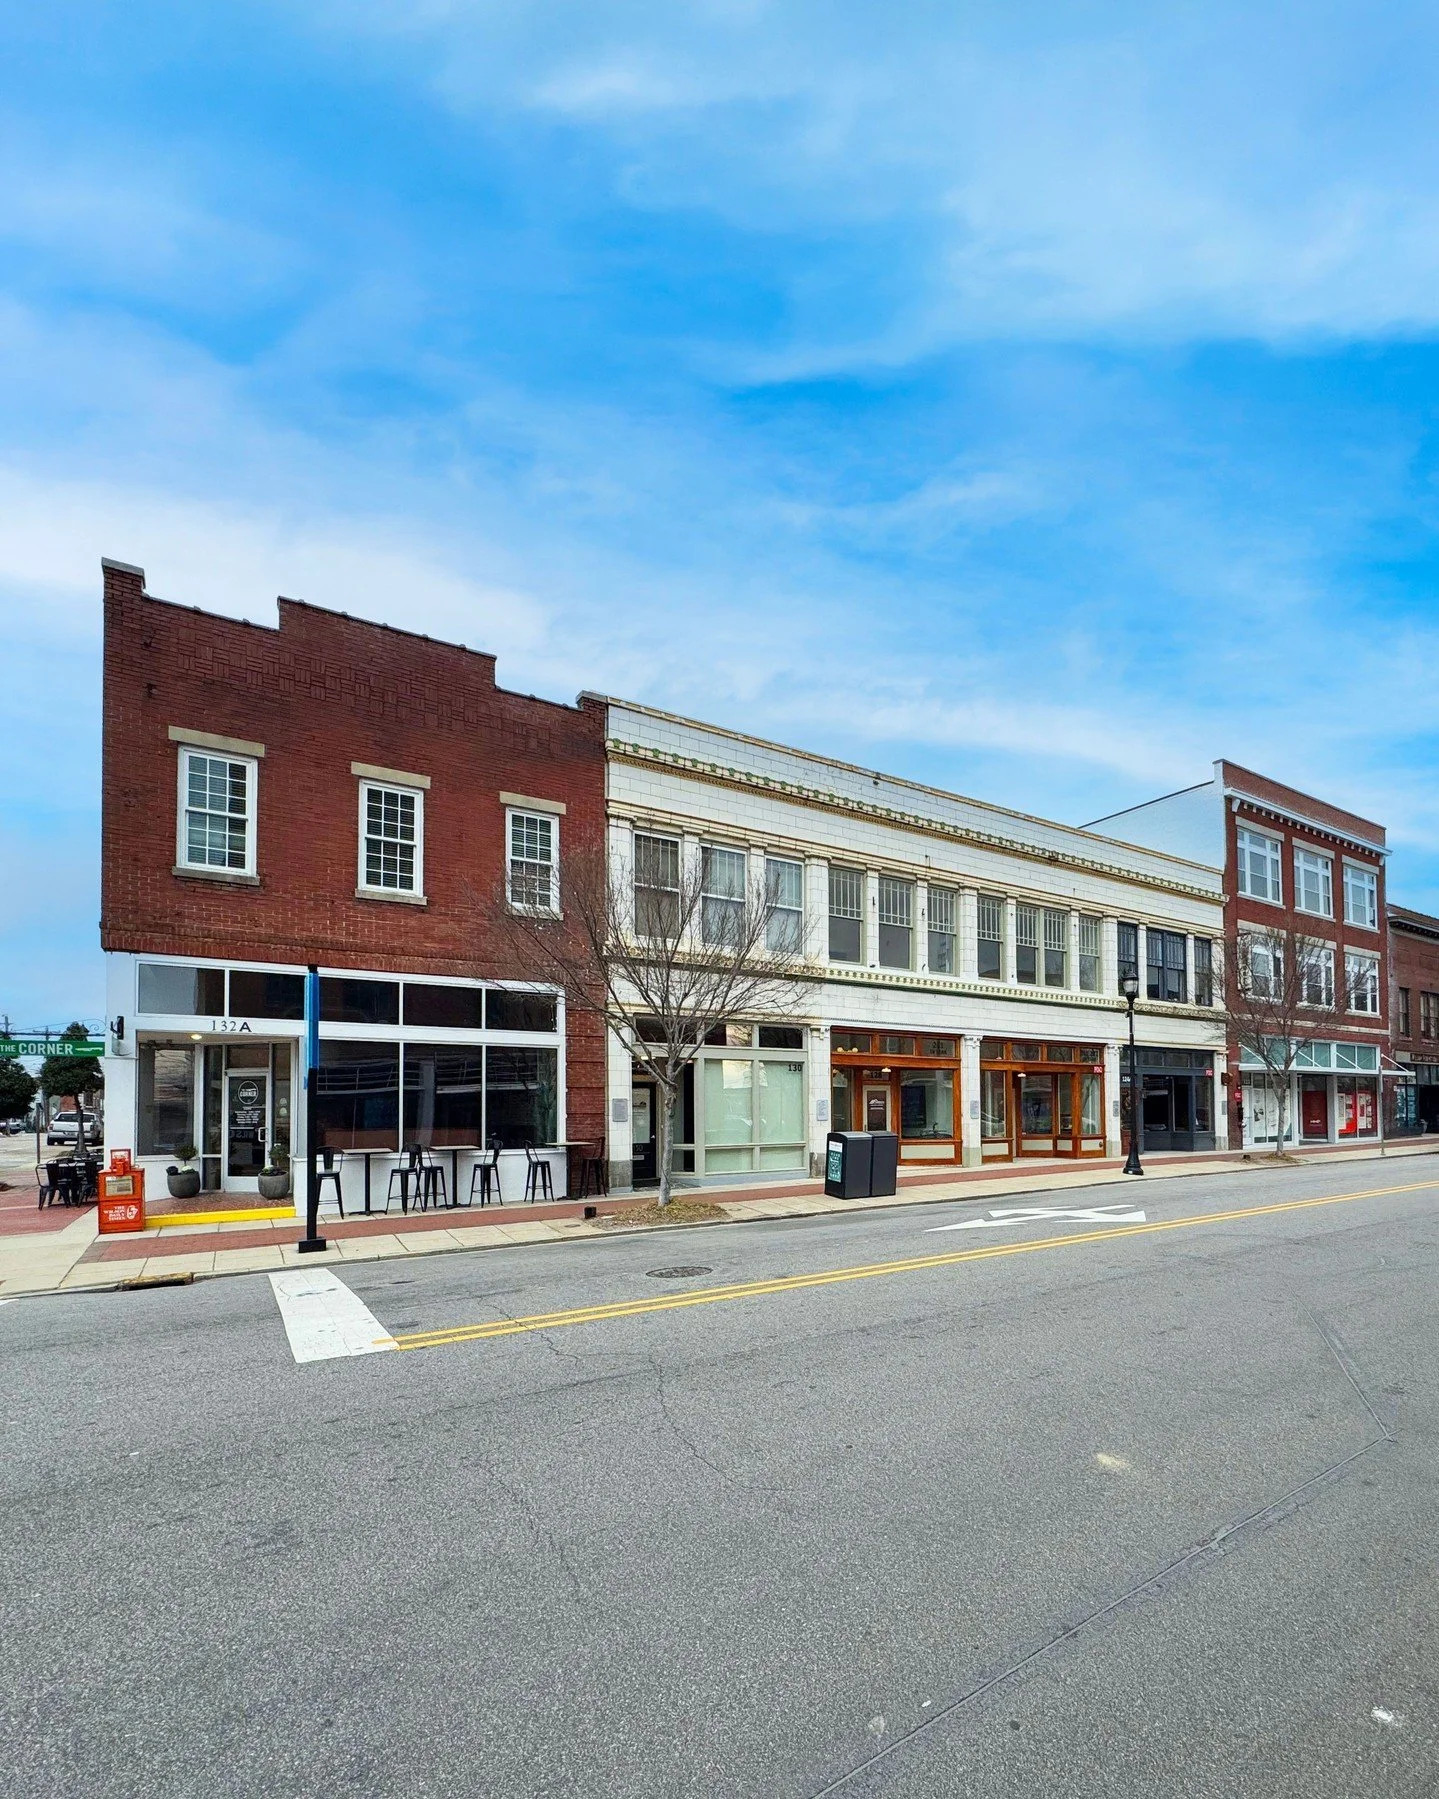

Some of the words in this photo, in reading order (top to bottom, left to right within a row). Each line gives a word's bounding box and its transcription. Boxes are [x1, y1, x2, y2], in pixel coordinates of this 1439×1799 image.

[212, 1020, 252, 1033] 132A
[0, 1044, 16, 1053] THE
[18, 1042, 74, 1055] CORNER
[788, 1063, 802, 1072] 130
